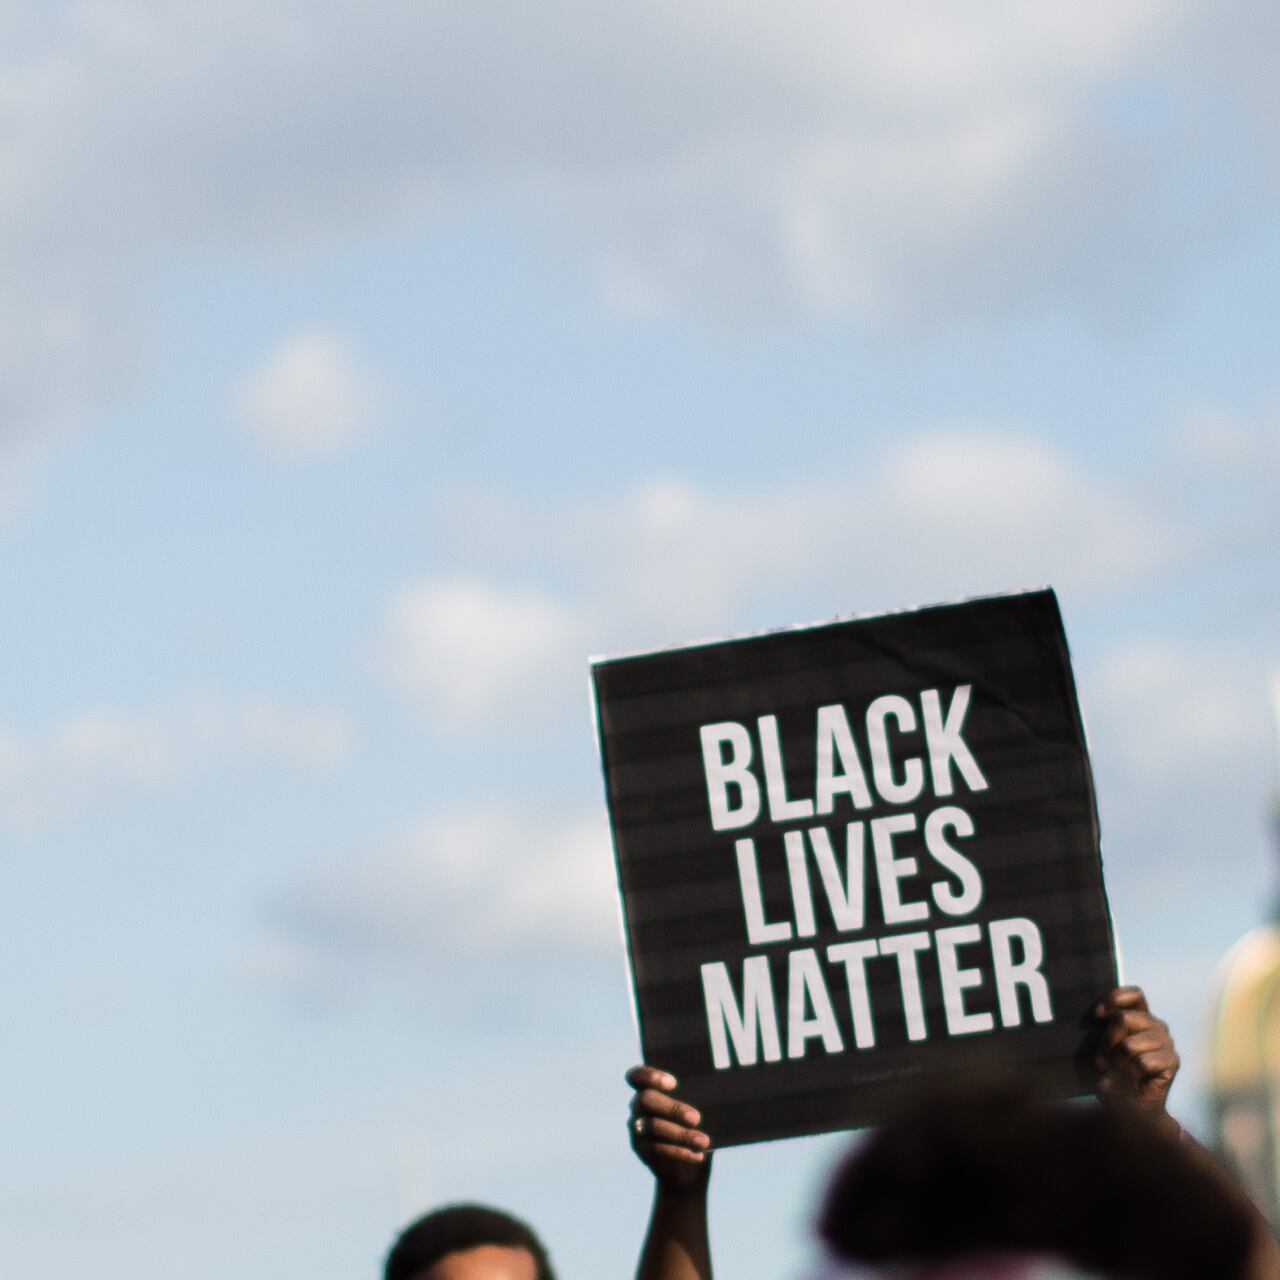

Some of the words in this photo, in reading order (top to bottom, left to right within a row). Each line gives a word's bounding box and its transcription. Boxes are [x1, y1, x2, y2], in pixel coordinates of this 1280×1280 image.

[700, 685, 988, 831] BLACK
[735, 806, 984, 945] LIVES
[700, 917, 1053, 1069] MATTER
